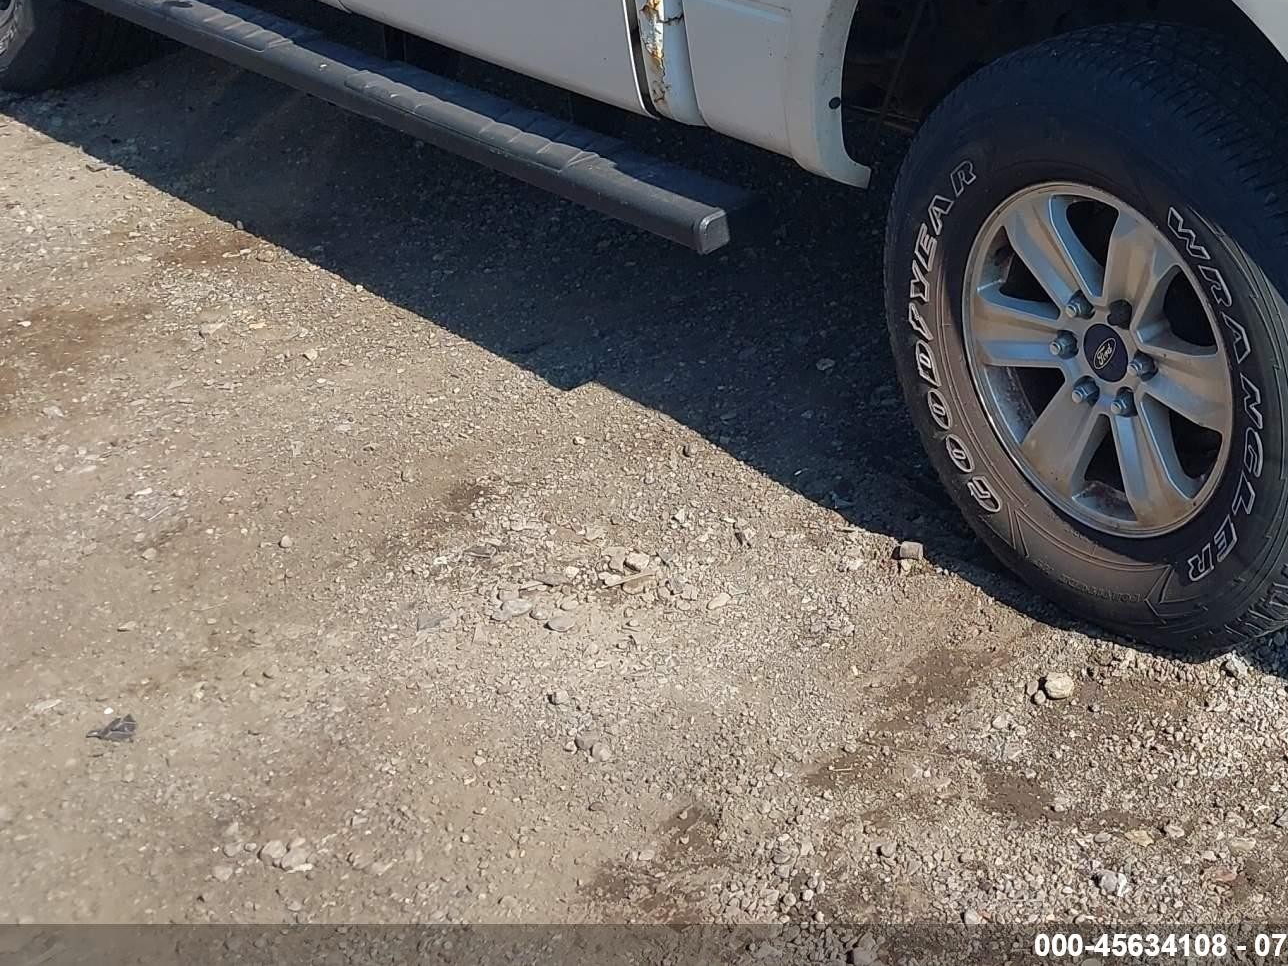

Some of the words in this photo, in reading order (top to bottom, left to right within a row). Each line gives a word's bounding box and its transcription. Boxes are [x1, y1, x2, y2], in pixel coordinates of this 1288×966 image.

[908, 159, 1002, 513] GOODYEAR
[1096, 342, 1113, 366] Ford
[1167, 206, 1264, 583] WRANGLER
